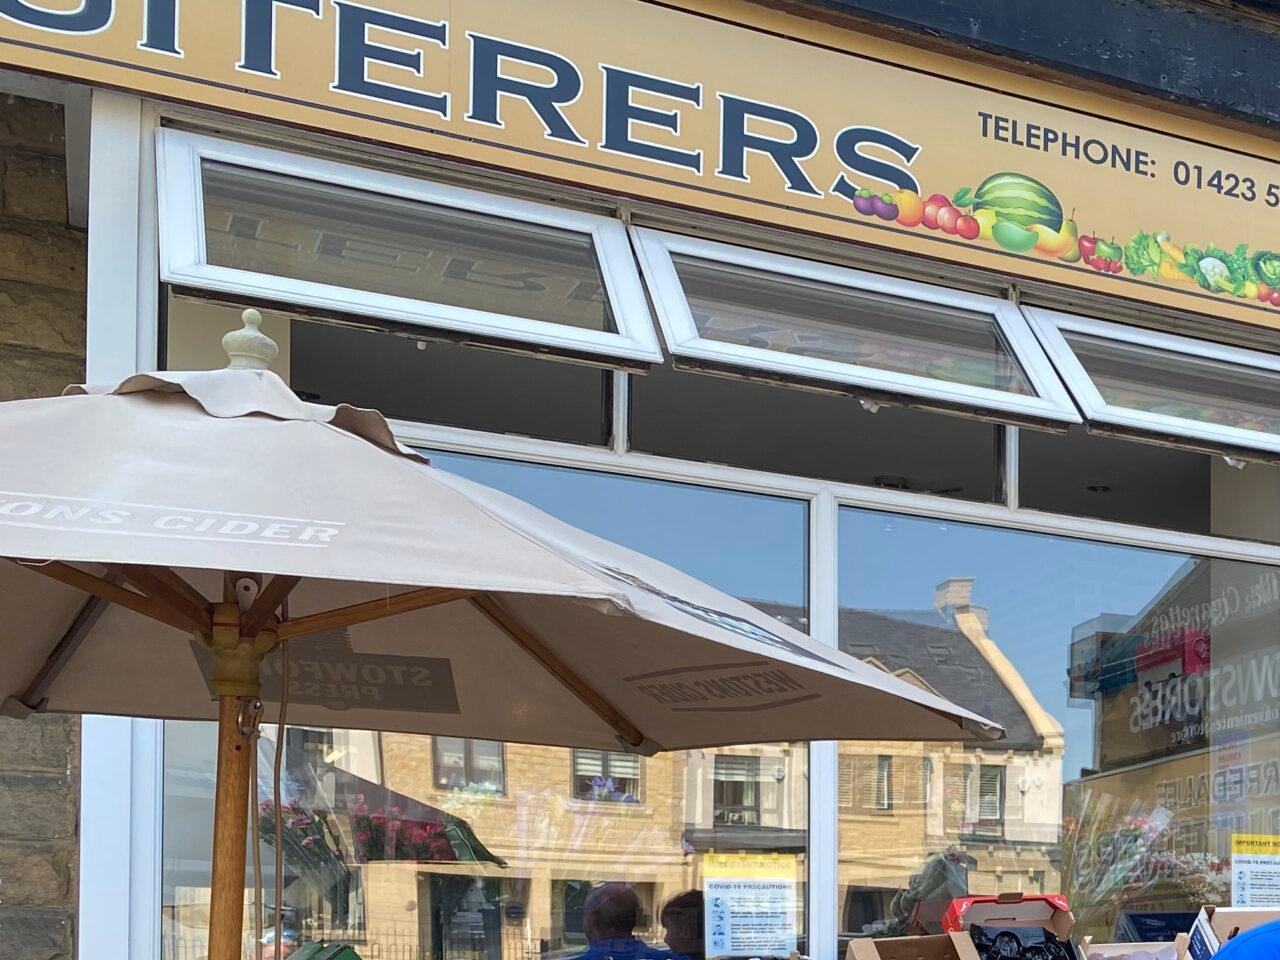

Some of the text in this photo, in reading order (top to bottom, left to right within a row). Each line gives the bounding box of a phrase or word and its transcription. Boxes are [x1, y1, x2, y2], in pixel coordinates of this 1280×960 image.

[978, 111, 1156, 180] TELEPHONE:
[1173, 160, 1257, 202] 01423
[152, 513, 340, 544] CIDER
